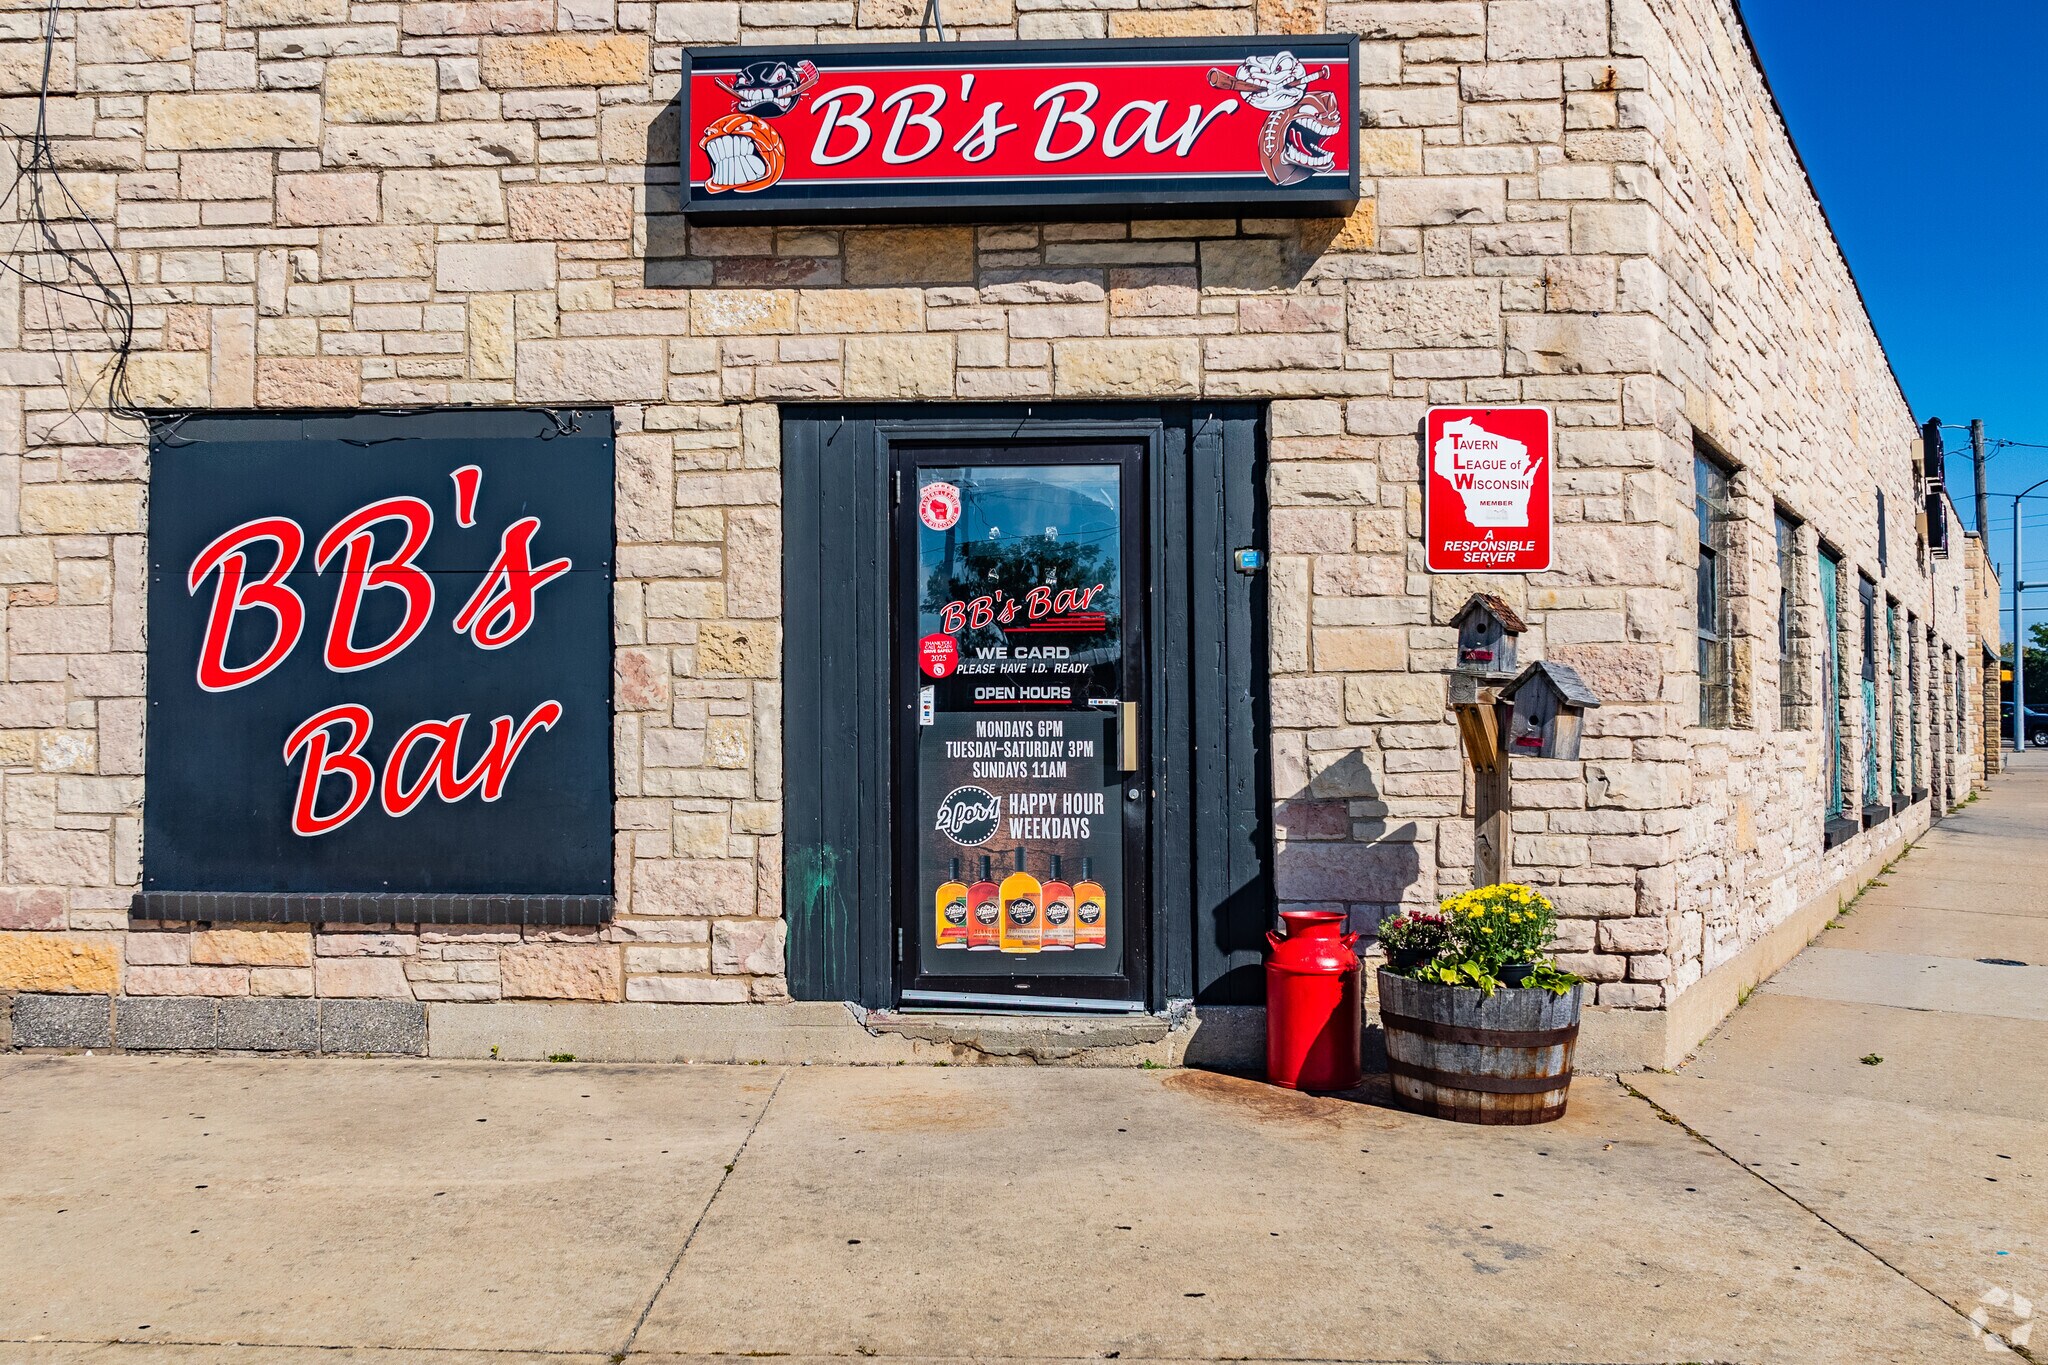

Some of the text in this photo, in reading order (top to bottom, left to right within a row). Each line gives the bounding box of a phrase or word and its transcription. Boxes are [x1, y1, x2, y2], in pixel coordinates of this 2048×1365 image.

[810, 74, 1239, 166] BB's Bar
[1449, 434, 1498, 450] TAVERN
[1453, 453, 1521, 470] LEAGUE of
[1454, 473, 1529, 490] WISCONSIN
[1484, 530, 1494, 540] A
[1444, 540, 1535, 551] RESPONSIBLE
[1463, 552, 1516, 563] SERVER
[188, 465, 572, 692] BB's
[940, 583, 1104, 634] BB's Bar
[976, 647, 1070, 659] WE CARD
[956, 663, 1089, 675] PLEASE HAVE I.D. READY
[974, 687, 1071, 699] OPEN HOURS
[976, 721, 1063, 737] MONDAYS 6PM
[1068, 741, 1094, 757] 3PM
[283, 700, 563, 836] Bar
[973, 761, 1067, 778] SUNDAYS 11AM
[1009, 793, 1104, 815] HAPPY HOUR
[935, 807, 951, 830] 2
[1009, 817, 1090, 839] WEEKDAYS
